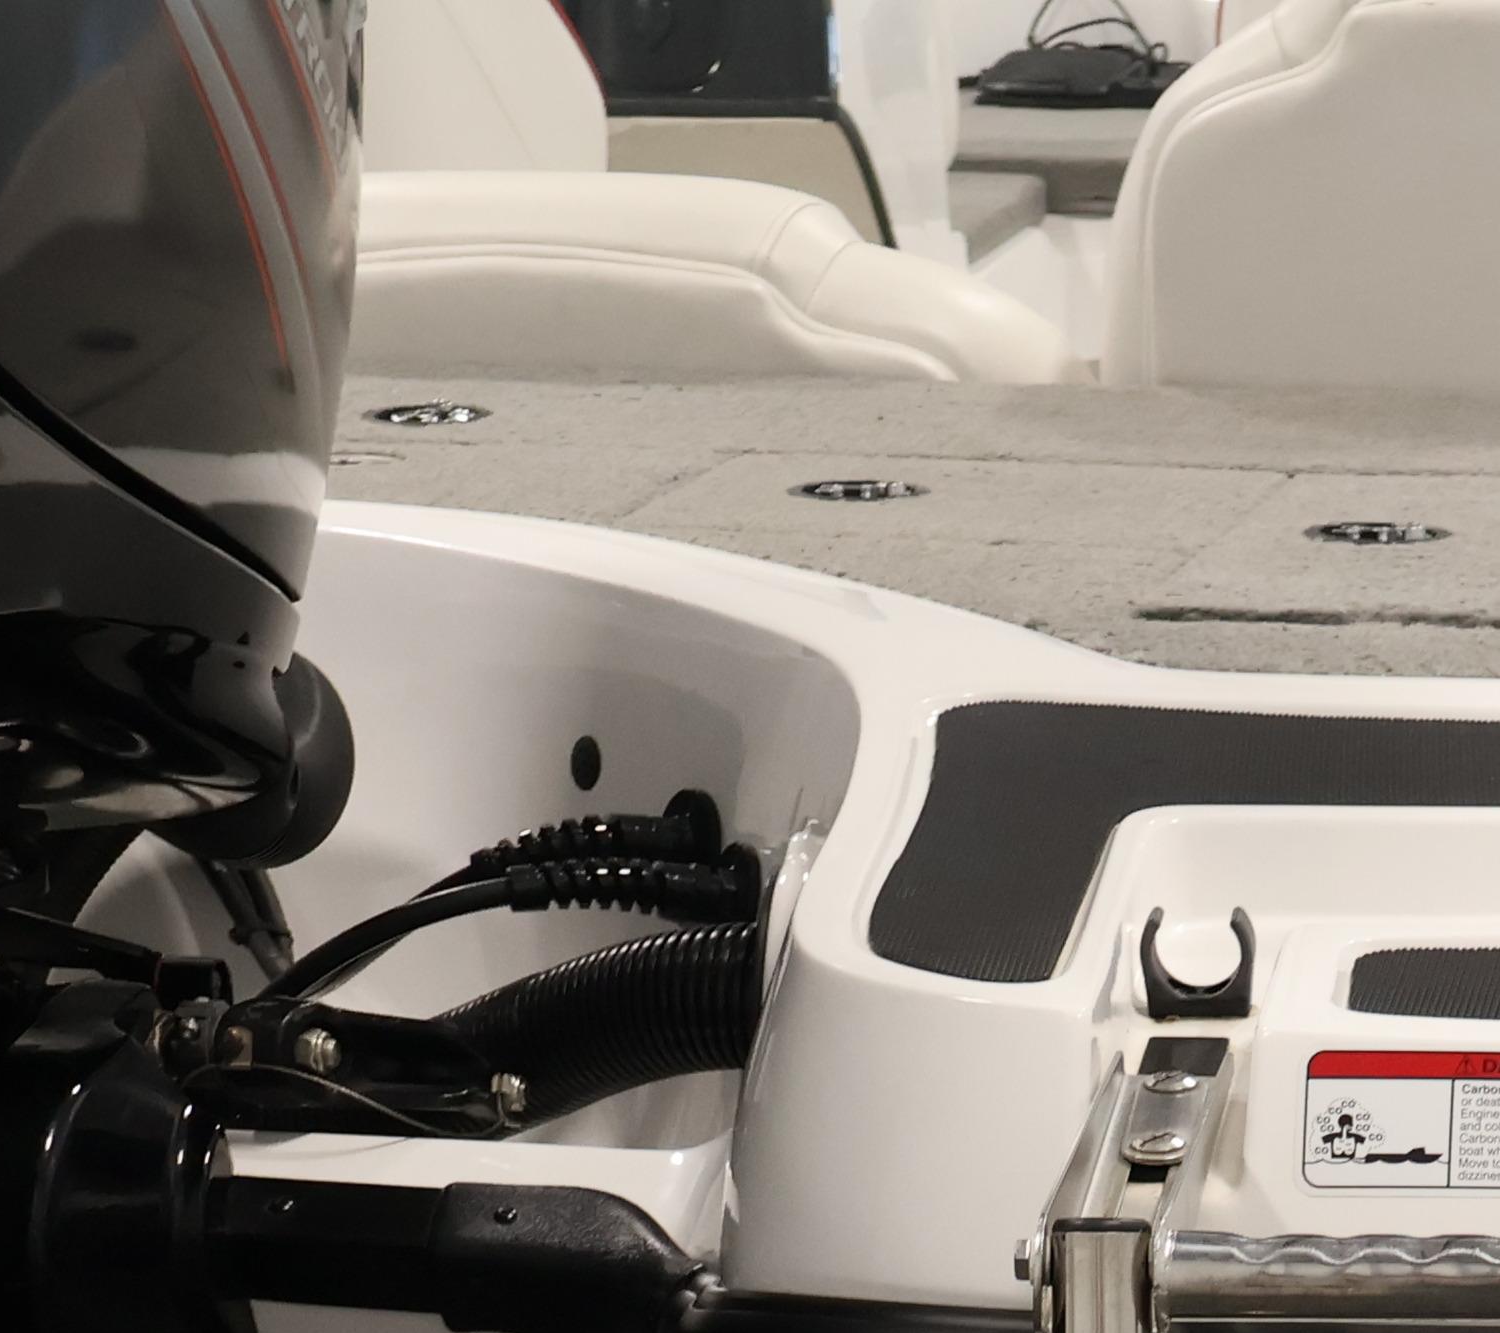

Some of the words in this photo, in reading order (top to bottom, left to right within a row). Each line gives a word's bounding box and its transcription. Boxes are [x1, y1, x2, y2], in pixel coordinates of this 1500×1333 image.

[1461, 1098, 1472, 1106] or
[1461, 1108, 1500, 1122] Engine
[1460, 1122, 1481, 1131] and
[1459, 1133, 1500, 1143] Carbon
[1459, 1145, 1484, 1156] boat
[1458, 1158, 1489, 1168] Move
